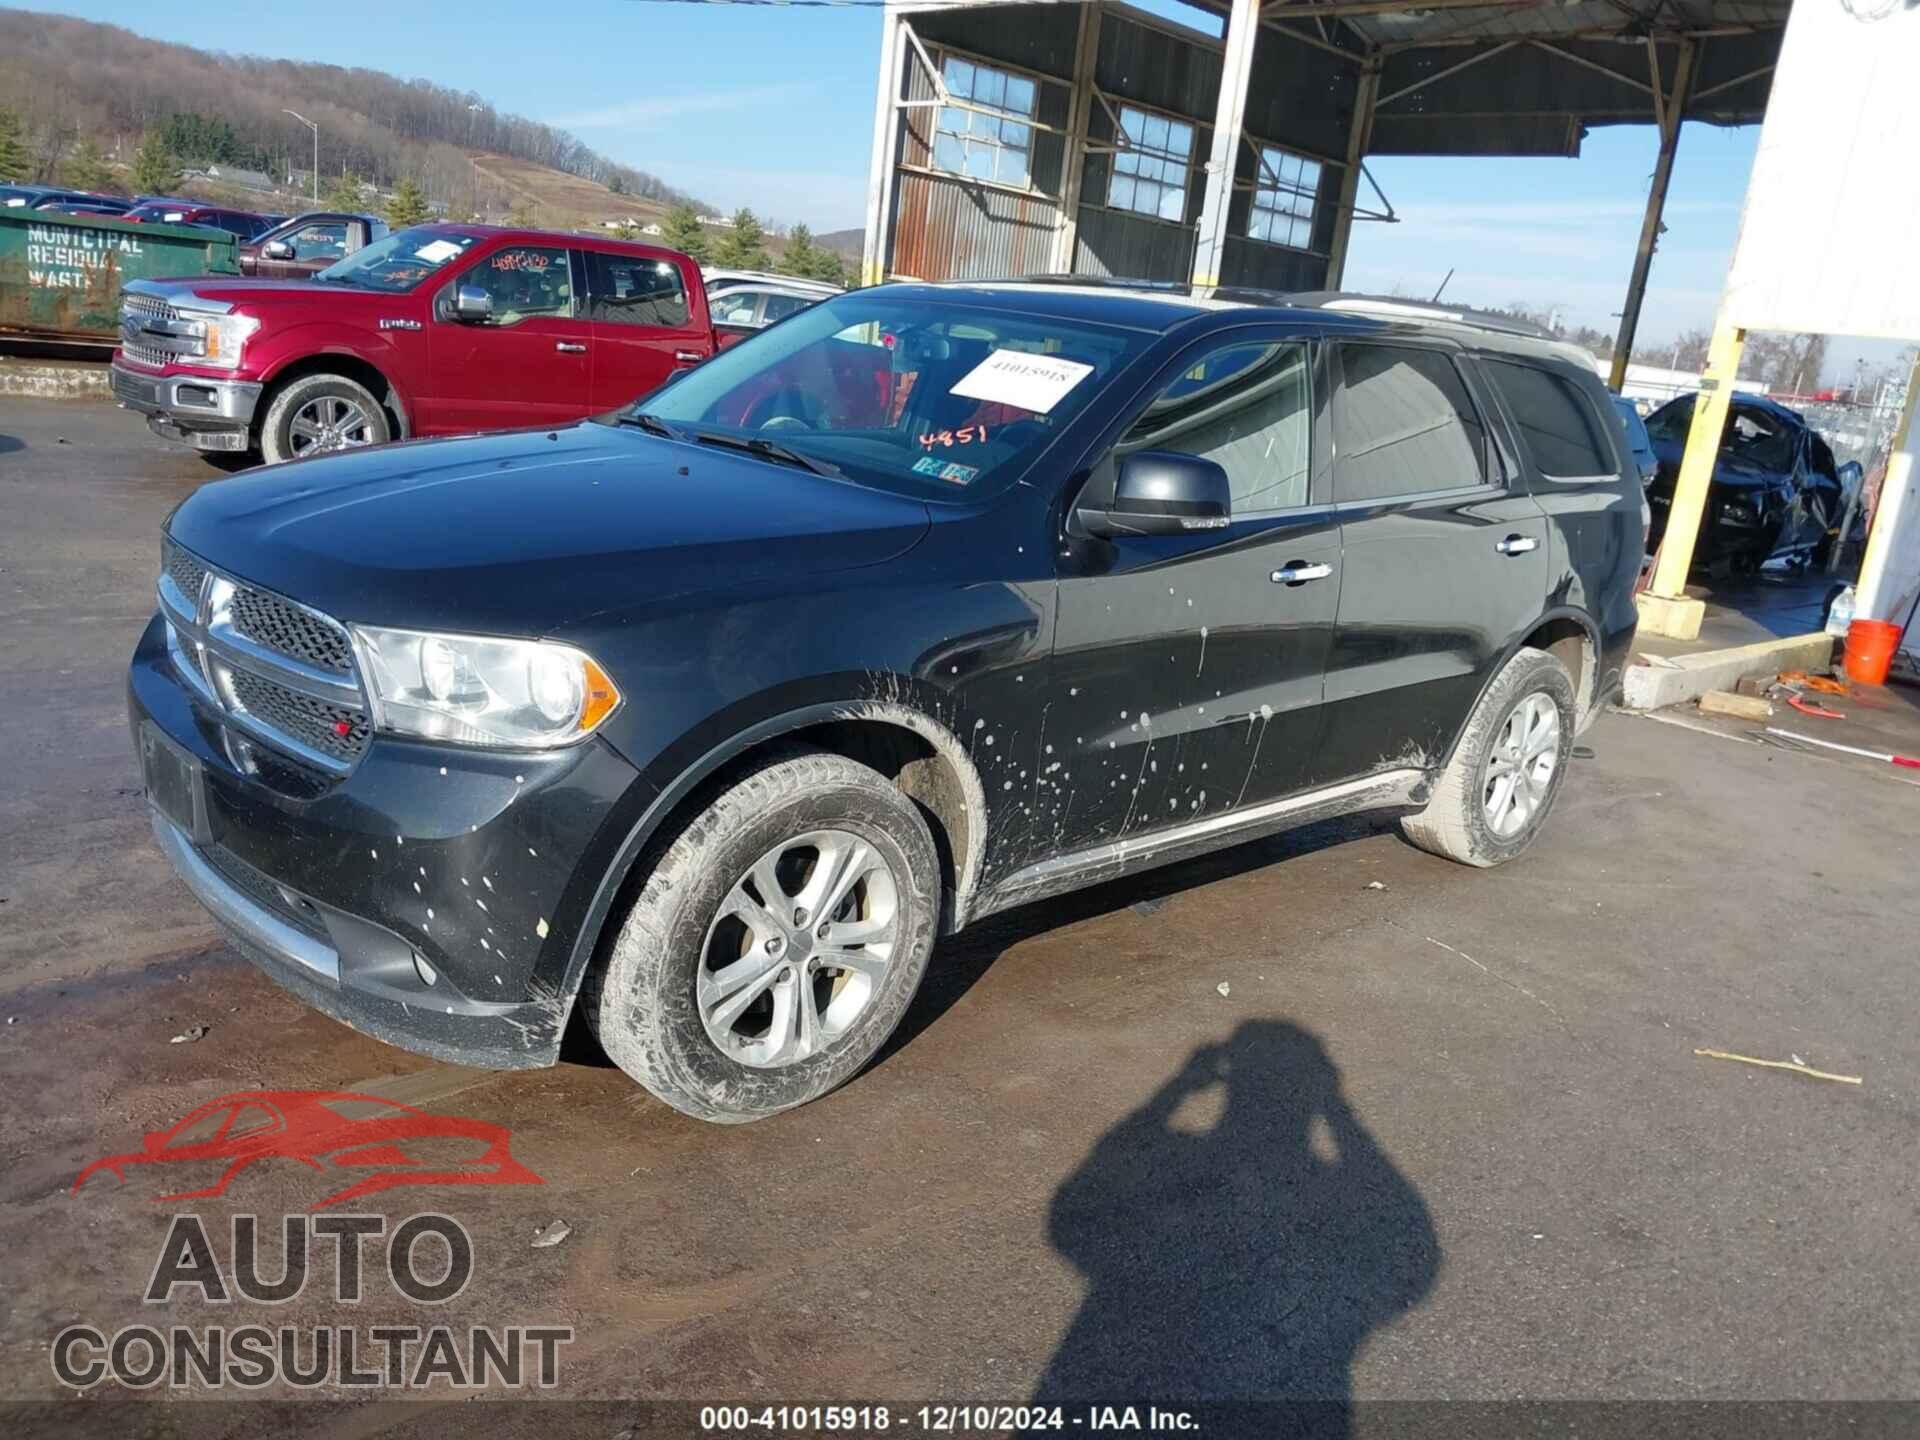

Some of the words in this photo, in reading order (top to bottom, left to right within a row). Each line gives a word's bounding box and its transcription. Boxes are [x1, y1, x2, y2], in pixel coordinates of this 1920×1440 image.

[27, 223, 143, 254] MUNICIPAL
[27, 244, 122, 271] RESIDUA
[919, 424, 986, 452] 4851
